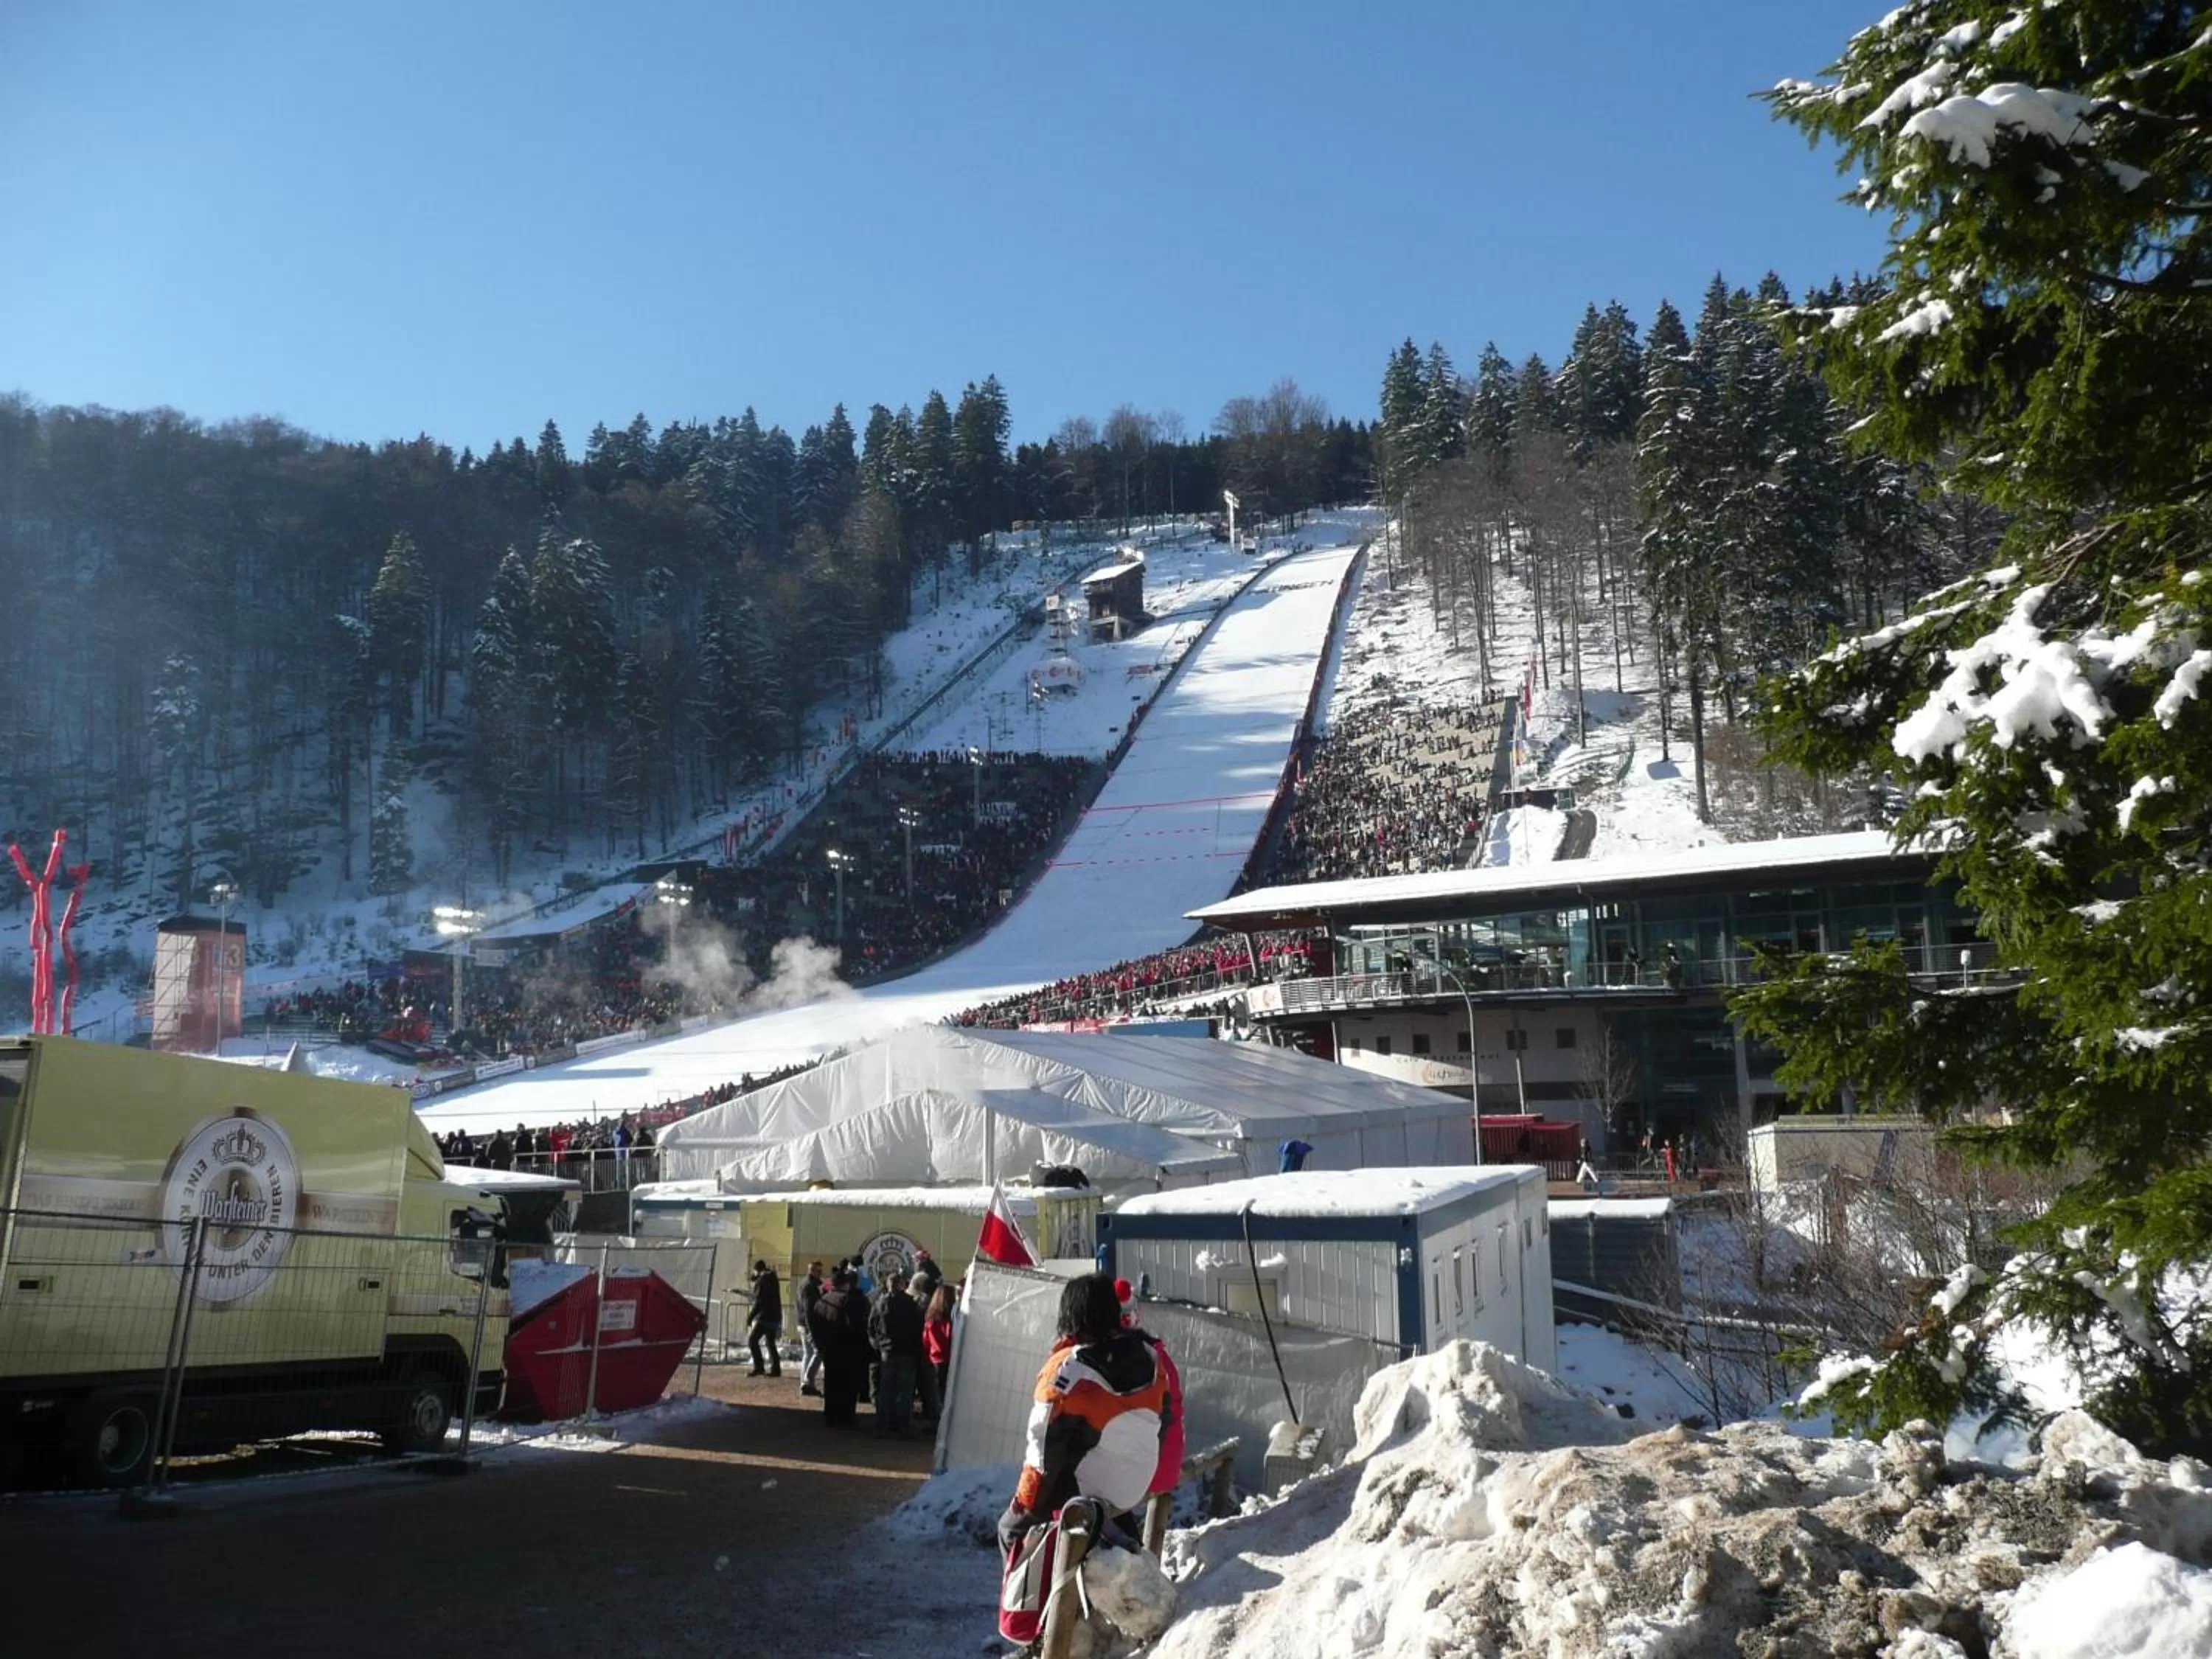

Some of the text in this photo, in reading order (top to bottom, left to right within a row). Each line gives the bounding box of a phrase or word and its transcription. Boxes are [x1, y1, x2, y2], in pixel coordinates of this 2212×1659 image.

[184, 1158, 208, 1197] EINE
[209, 1259, 249, 1279] UNTER
[252, 1231, 274, 1263] DEN
[266, 1163, 283, 1225] BIEREN
[201, 1179, 267, 1225] Warsteiner
